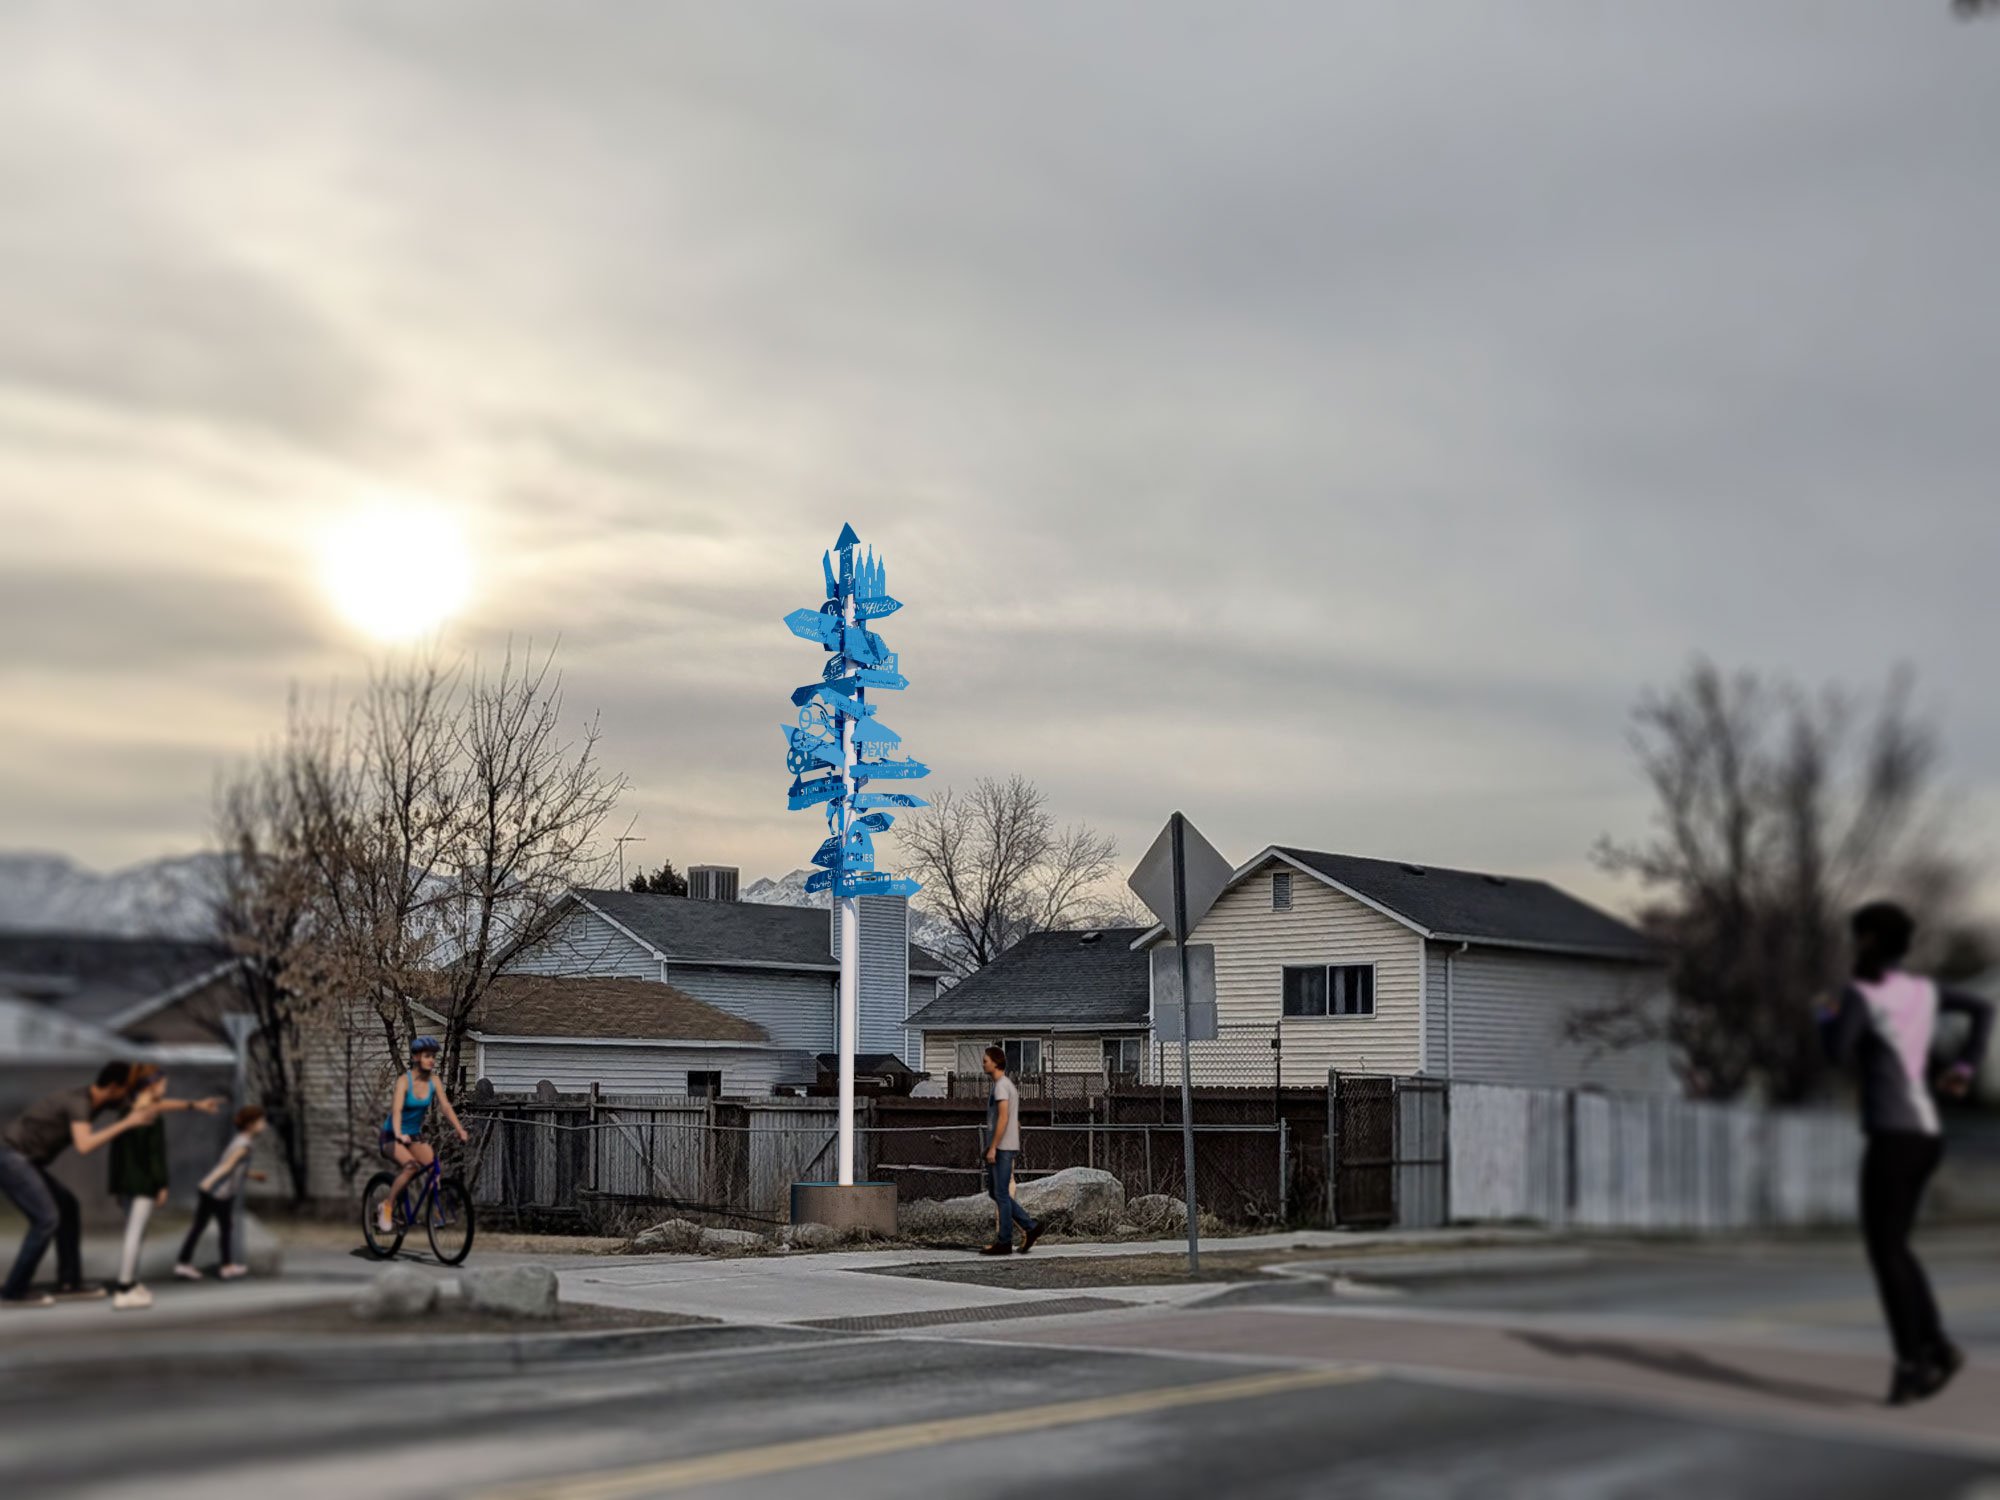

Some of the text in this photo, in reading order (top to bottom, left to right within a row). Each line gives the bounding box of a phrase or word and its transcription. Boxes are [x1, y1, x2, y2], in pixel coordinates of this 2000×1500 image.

[854, 741, 899, 750] ENSIGN
[861, 748, 890, 757] PEAK
[846, 852, 874, 862] ARCHES
